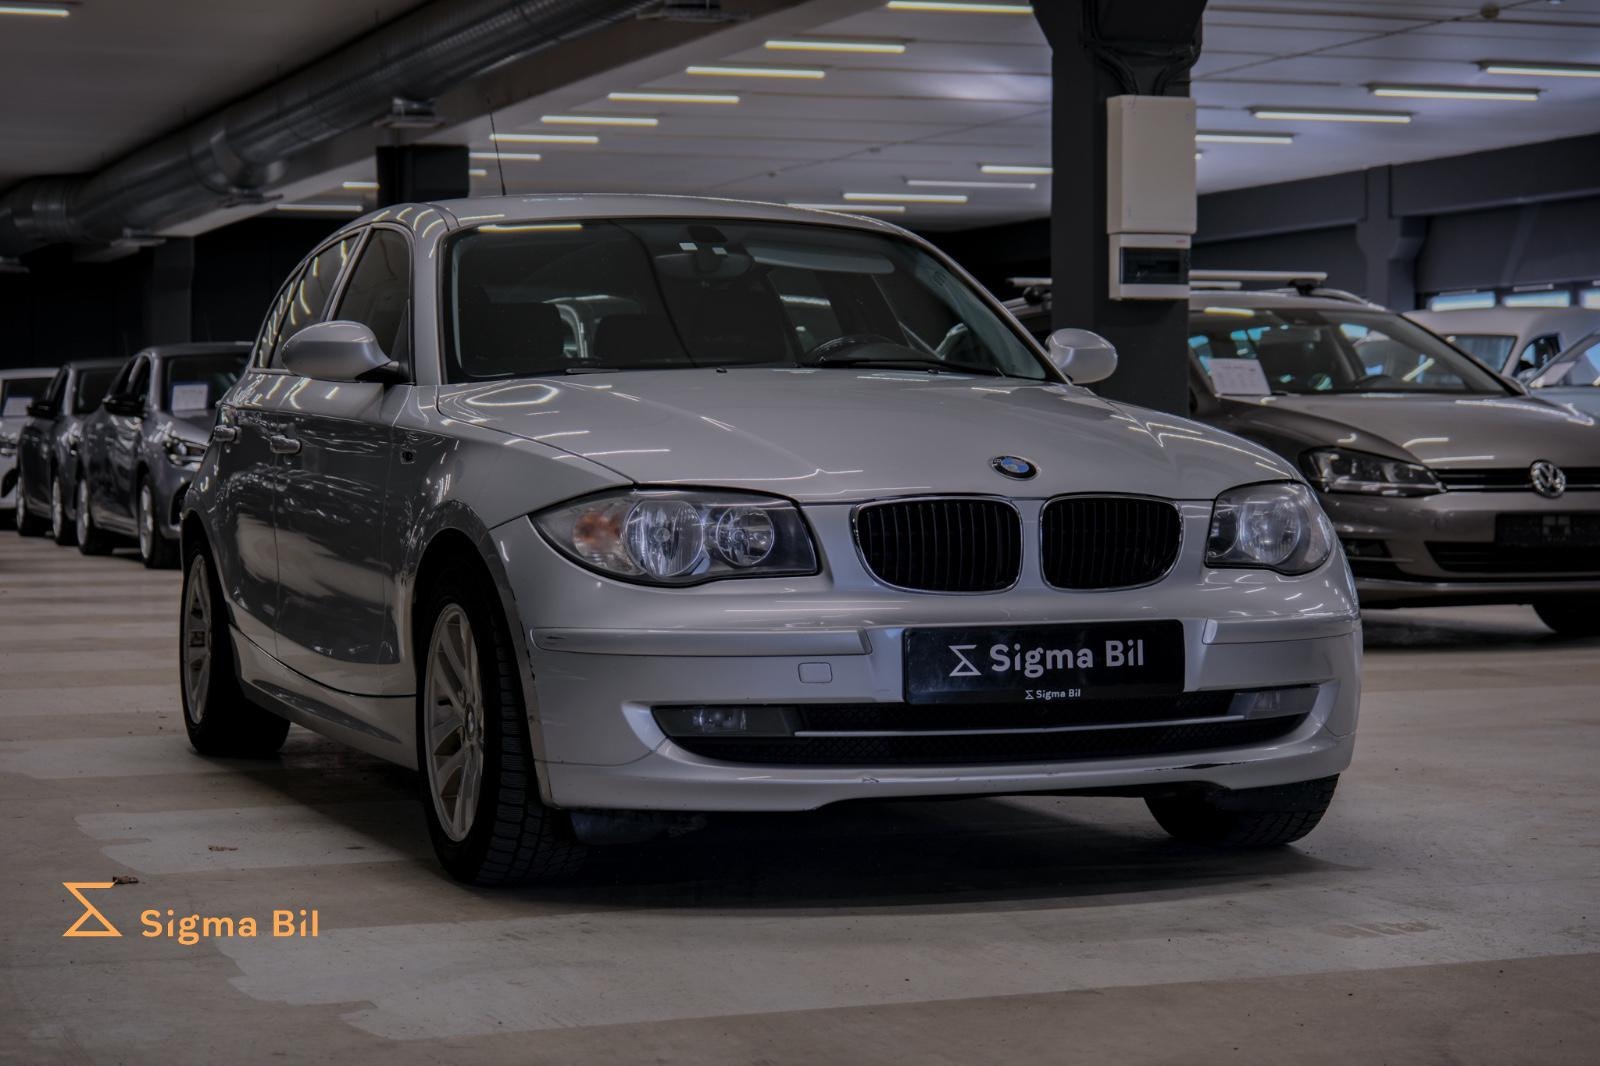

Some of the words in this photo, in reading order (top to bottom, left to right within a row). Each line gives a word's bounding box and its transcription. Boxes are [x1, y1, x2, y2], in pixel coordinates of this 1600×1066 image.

[989, 643, 1094, 678] Sigma
[1105, 639, 1144, 667] Bil
[1036, 689, 1066, 700] Sigma
[1068, 688, 1081, 698] Bil
